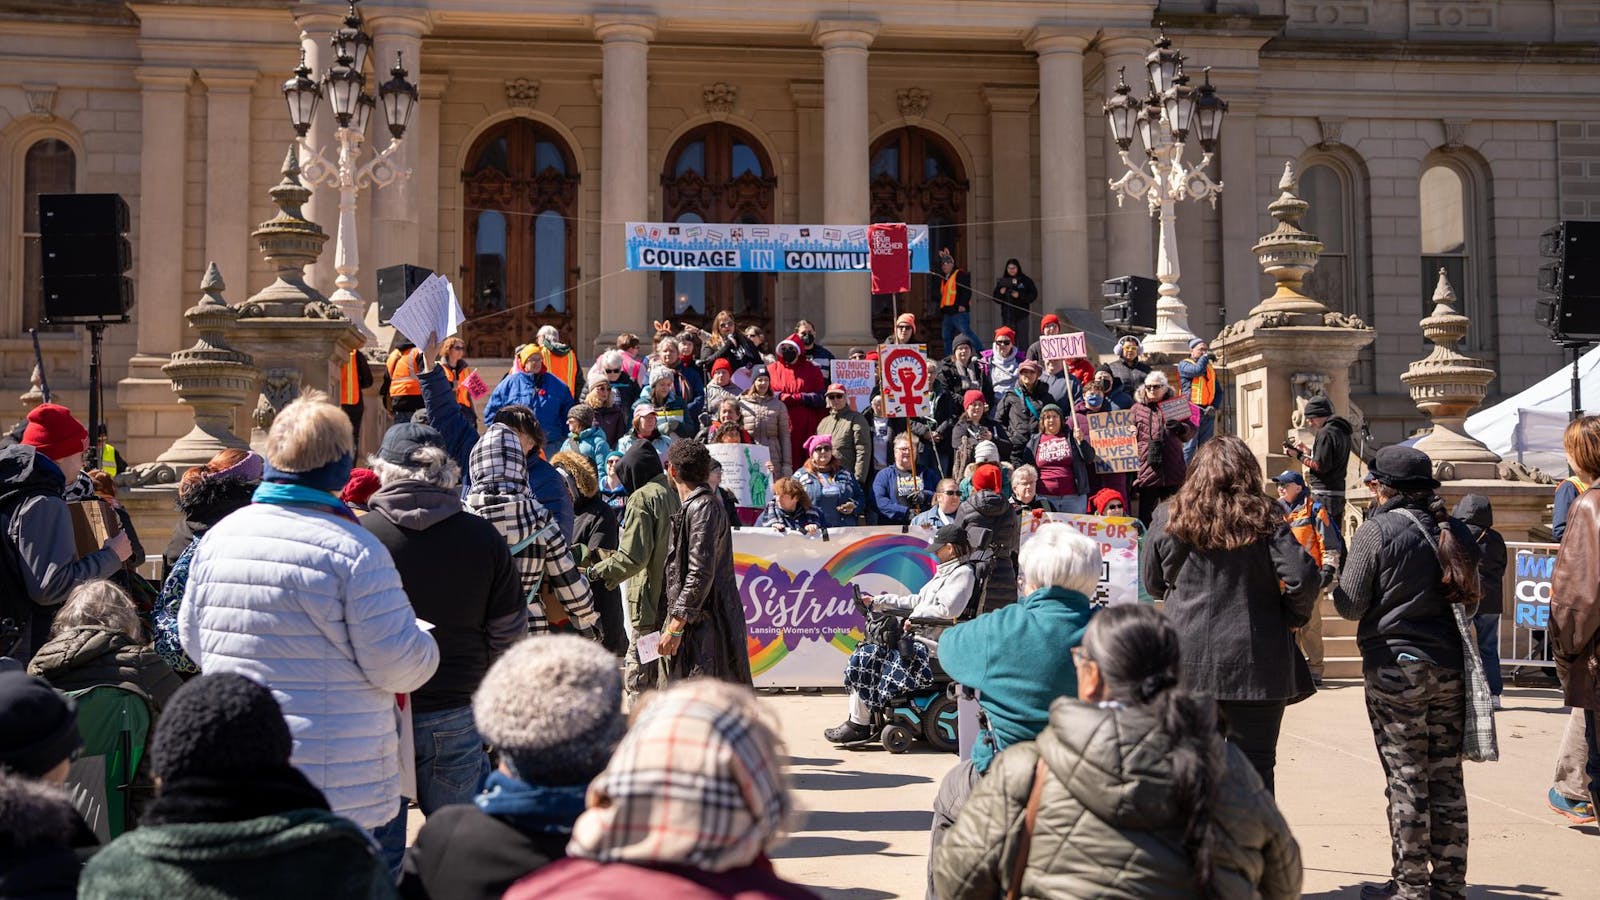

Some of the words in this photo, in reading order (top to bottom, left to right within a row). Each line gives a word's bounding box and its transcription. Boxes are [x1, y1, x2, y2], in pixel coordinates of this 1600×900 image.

[642, 248, 736, 268] COURAGE
[752, 250, 772, 269] IN
[786, 252, 871, 271] COMMU
[1040, 335, 1085, 358] SISTRUM
[835, 361, 847, 369] SO
[848, 361, 870, 370] MUCH
[836, 370, 870, 379] WRONG
[1090, 411, 1132, 429] BLACK
[1095, 425, 1133, 438] TRANS
[1098, 444, 1134, 458] LIVES
[1095, 456, 1141, 472] MATTER
[1105, 524, 1128, 538] OR
[1516, 580, 1552, 603] CO
[745, 575, 856, 627] Sistru
[1516, 603, 1551, 627] RE
[750, 626, 781, 636] Lansing
[782, 626, 820, 634] Women's
[821, 626, 851, 634] Chorus
